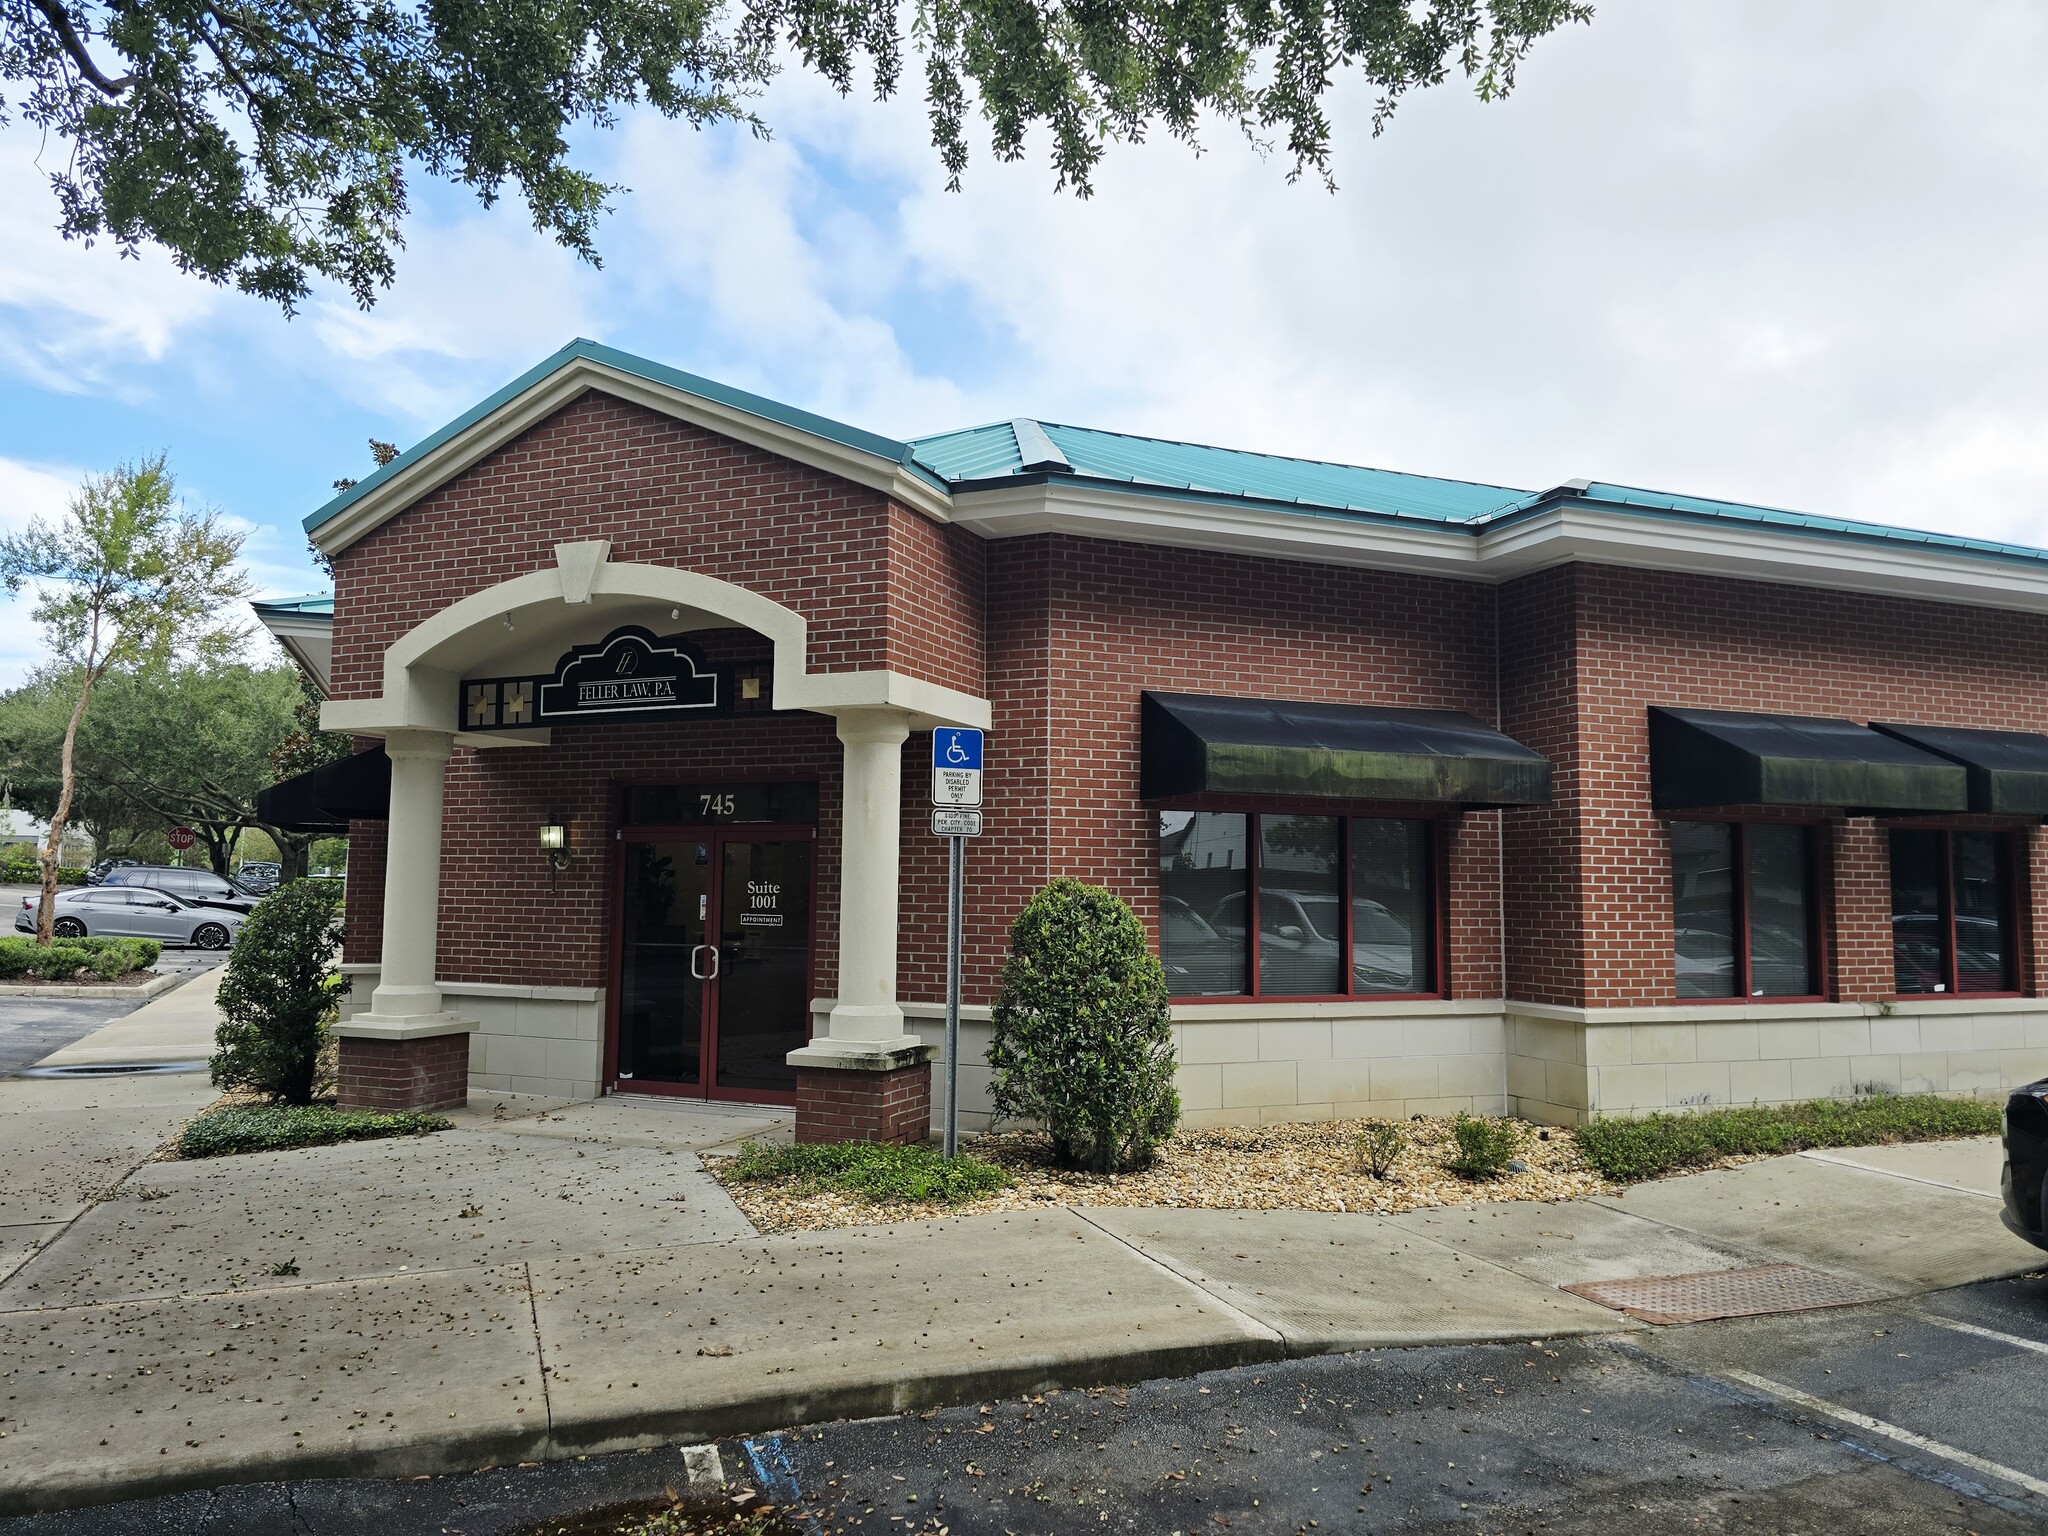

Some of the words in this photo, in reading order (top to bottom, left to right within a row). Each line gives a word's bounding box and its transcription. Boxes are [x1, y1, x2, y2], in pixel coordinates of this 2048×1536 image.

[579, 684, 619, 700] FELLER
[655, 682, 675, 696] P.A.
[943, 771, 964, 779] PARKING
[700, 794, 735, 815] 745
[170, 833, 194, 843] STOP
[747, 881, 780, 894] Suite
[750, 895, 777, 908] 1001
